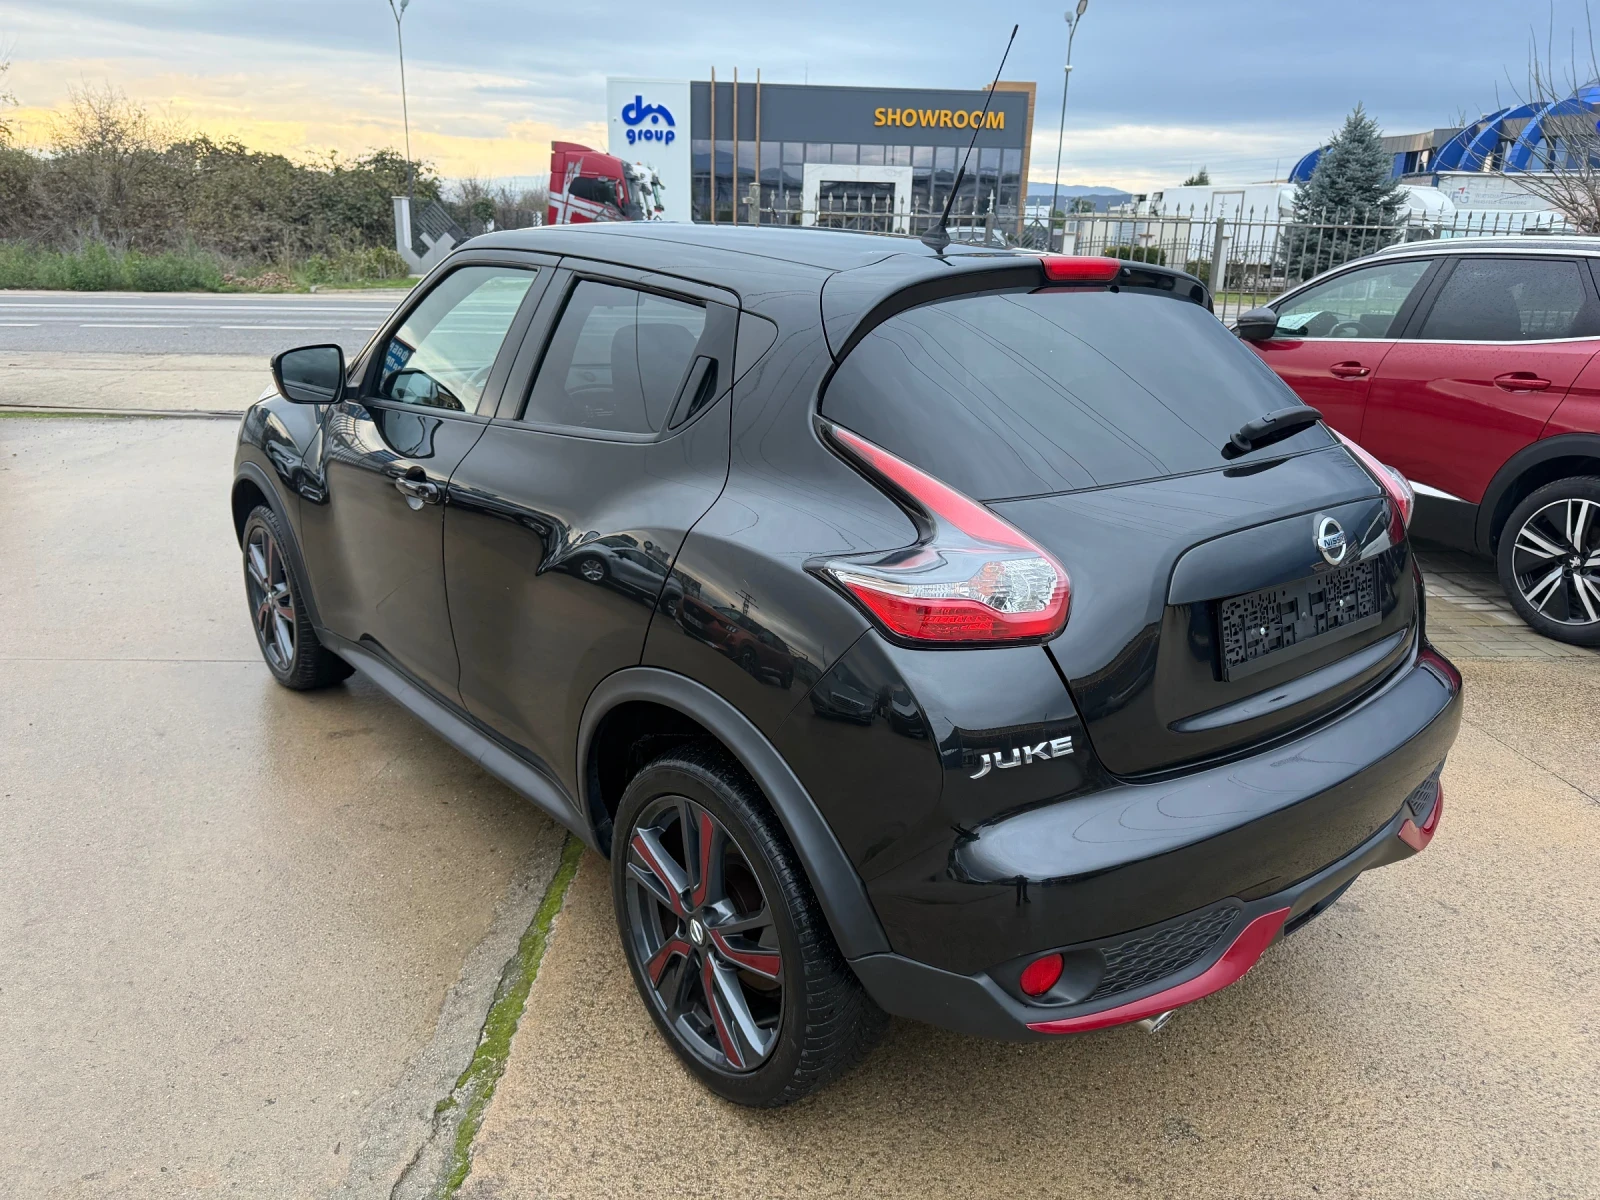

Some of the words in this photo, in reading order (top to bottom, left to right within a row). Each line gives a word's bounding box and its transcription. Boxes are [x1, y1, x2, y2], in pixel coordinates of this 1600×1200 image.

[874, 107, 1005, 129] SHOWROOM
[626, 128, 675, 145] group
[969, 735, 1075, 780] JUKE
